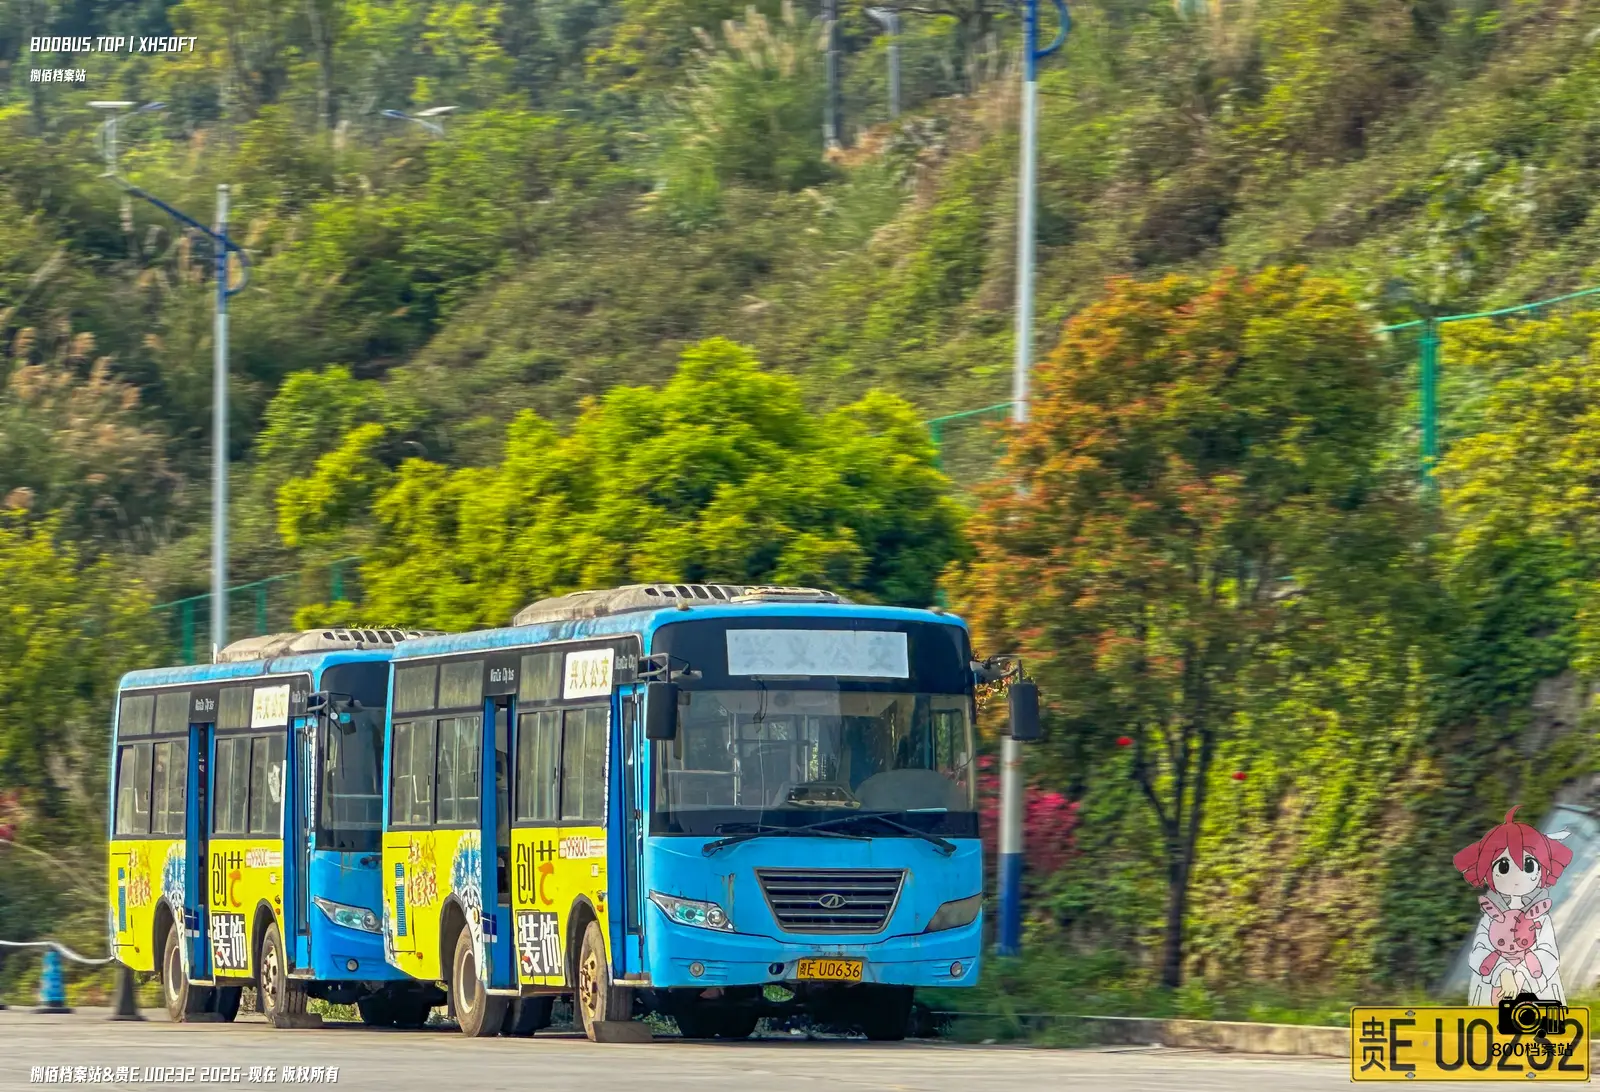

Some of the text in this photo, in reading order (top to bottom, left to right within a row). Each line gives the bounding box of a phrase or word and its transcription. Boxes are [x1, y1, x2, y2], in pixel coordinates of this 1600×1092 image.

[213, 915, 248, 968] 装饰
[517, 913, 562, 974] 装饰
[818, 963, 861, 978] U0636
